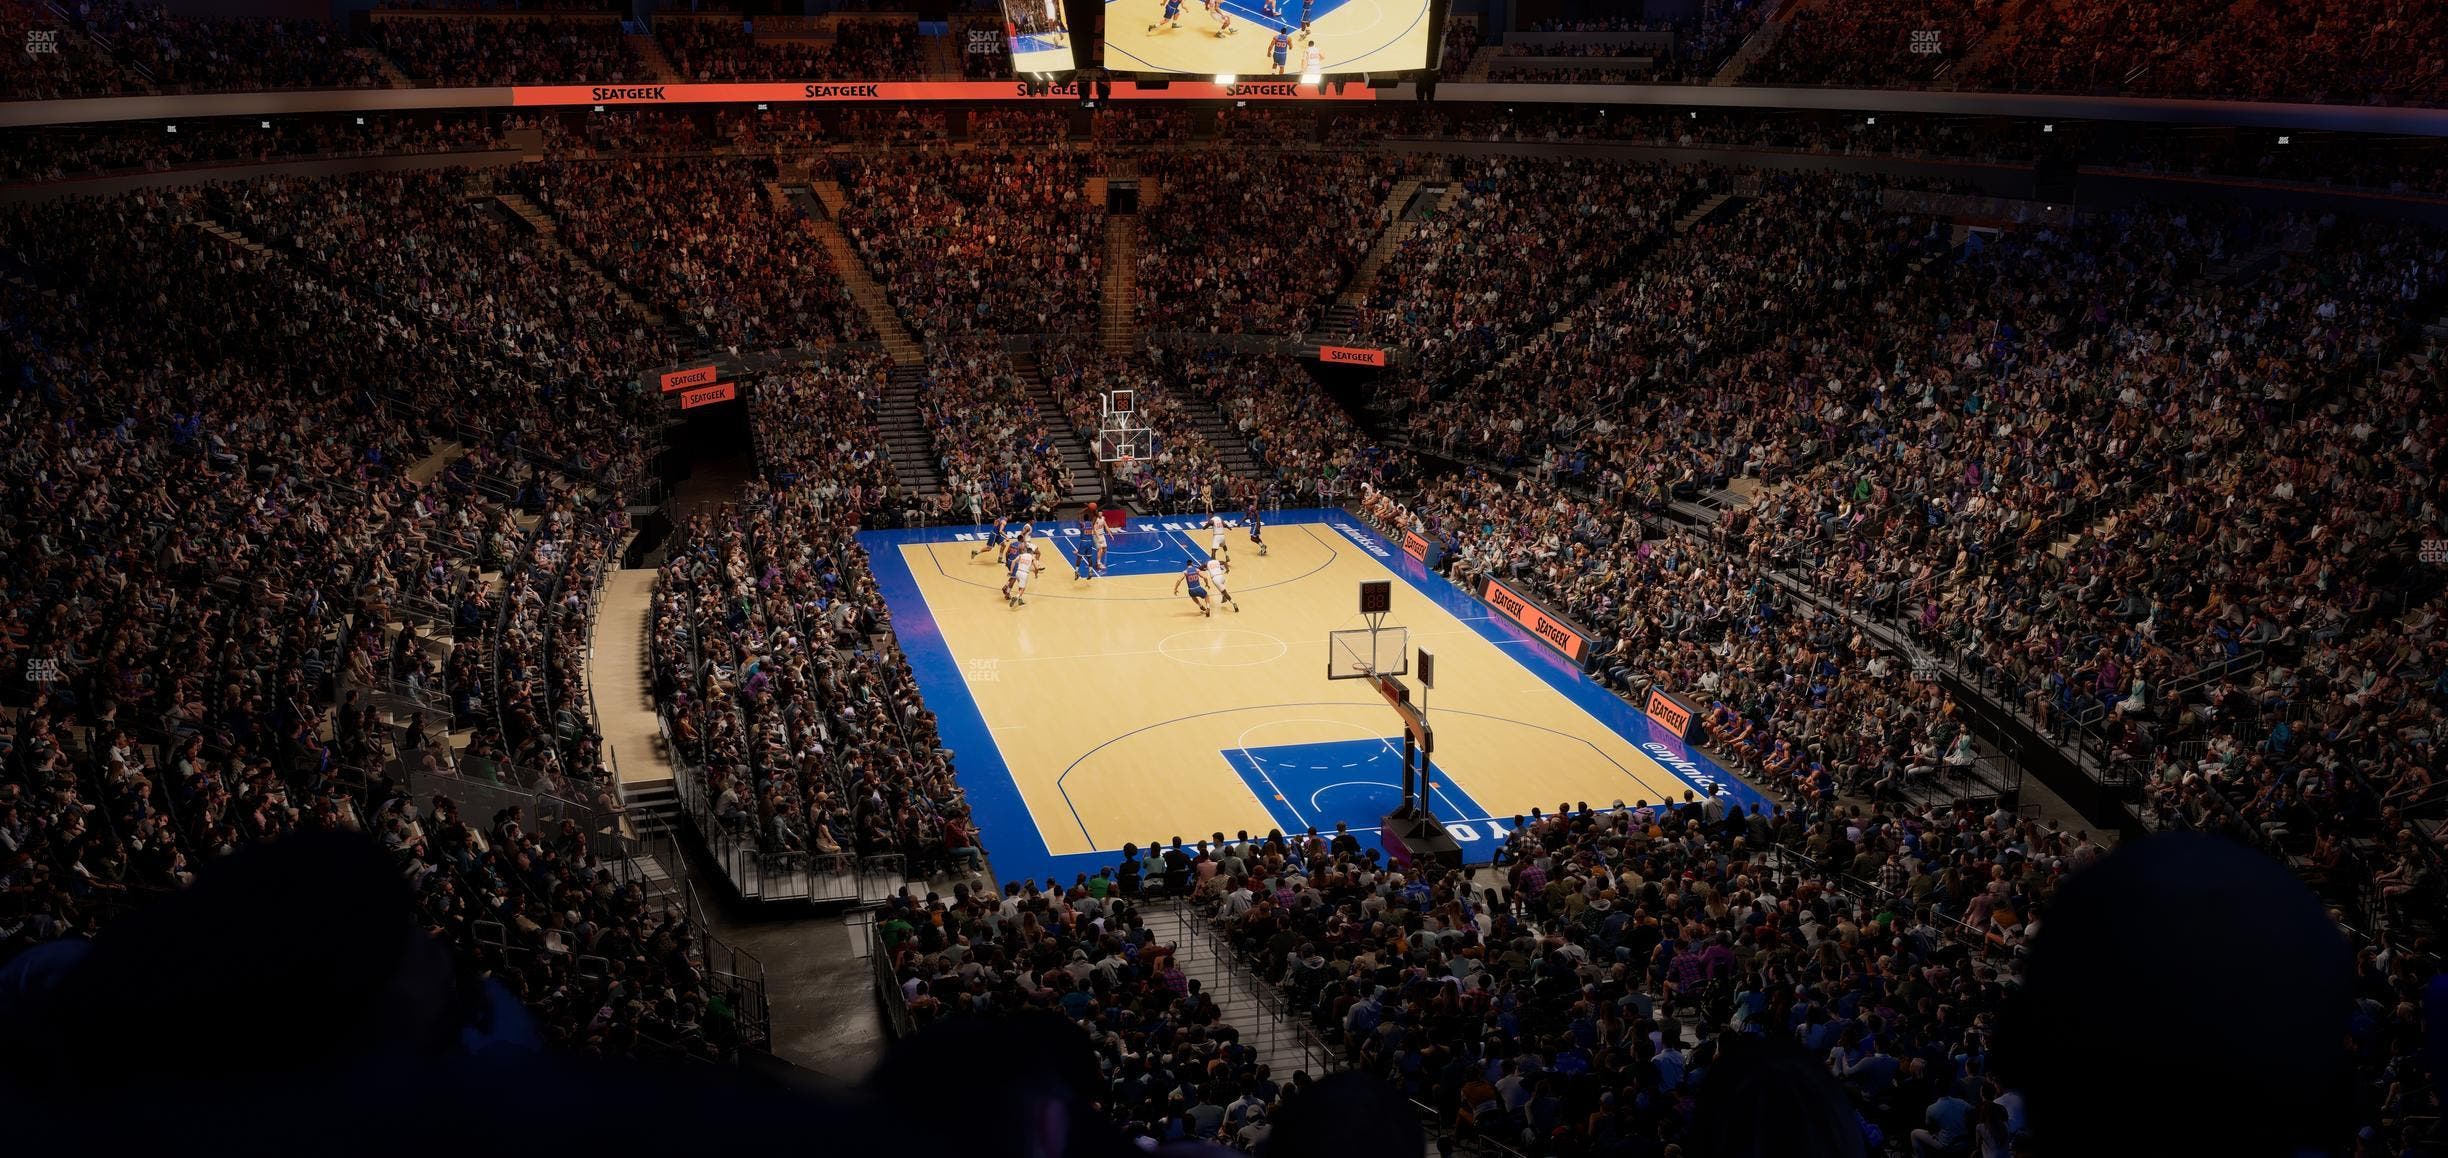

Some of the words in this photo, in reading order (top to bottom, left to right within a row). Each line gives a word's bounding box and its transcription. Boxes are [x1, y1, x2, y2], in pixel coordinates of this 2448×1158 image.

[592, 86, 666, 101] SEATGEEK
[805, 84, 878, 98] SEATGEEK
[1226, 83, 1298, 97] SEATGEEK
[1331, 350, 1375, 364] SEATGEEK
[670, 371, 707, 387] SEATGEEK
[690, 388, 726, 405] SEATGEEK
[1037, 526, 1128, 537] YOK
[1404, 535, 1427, 561] SEATGEEK
[1492, 588, 1525, 620] SEATGEEK
[1535, 616, 1571, 652] SEATGEEK
[1650, 697, 1687, 734] SEATGEEK
